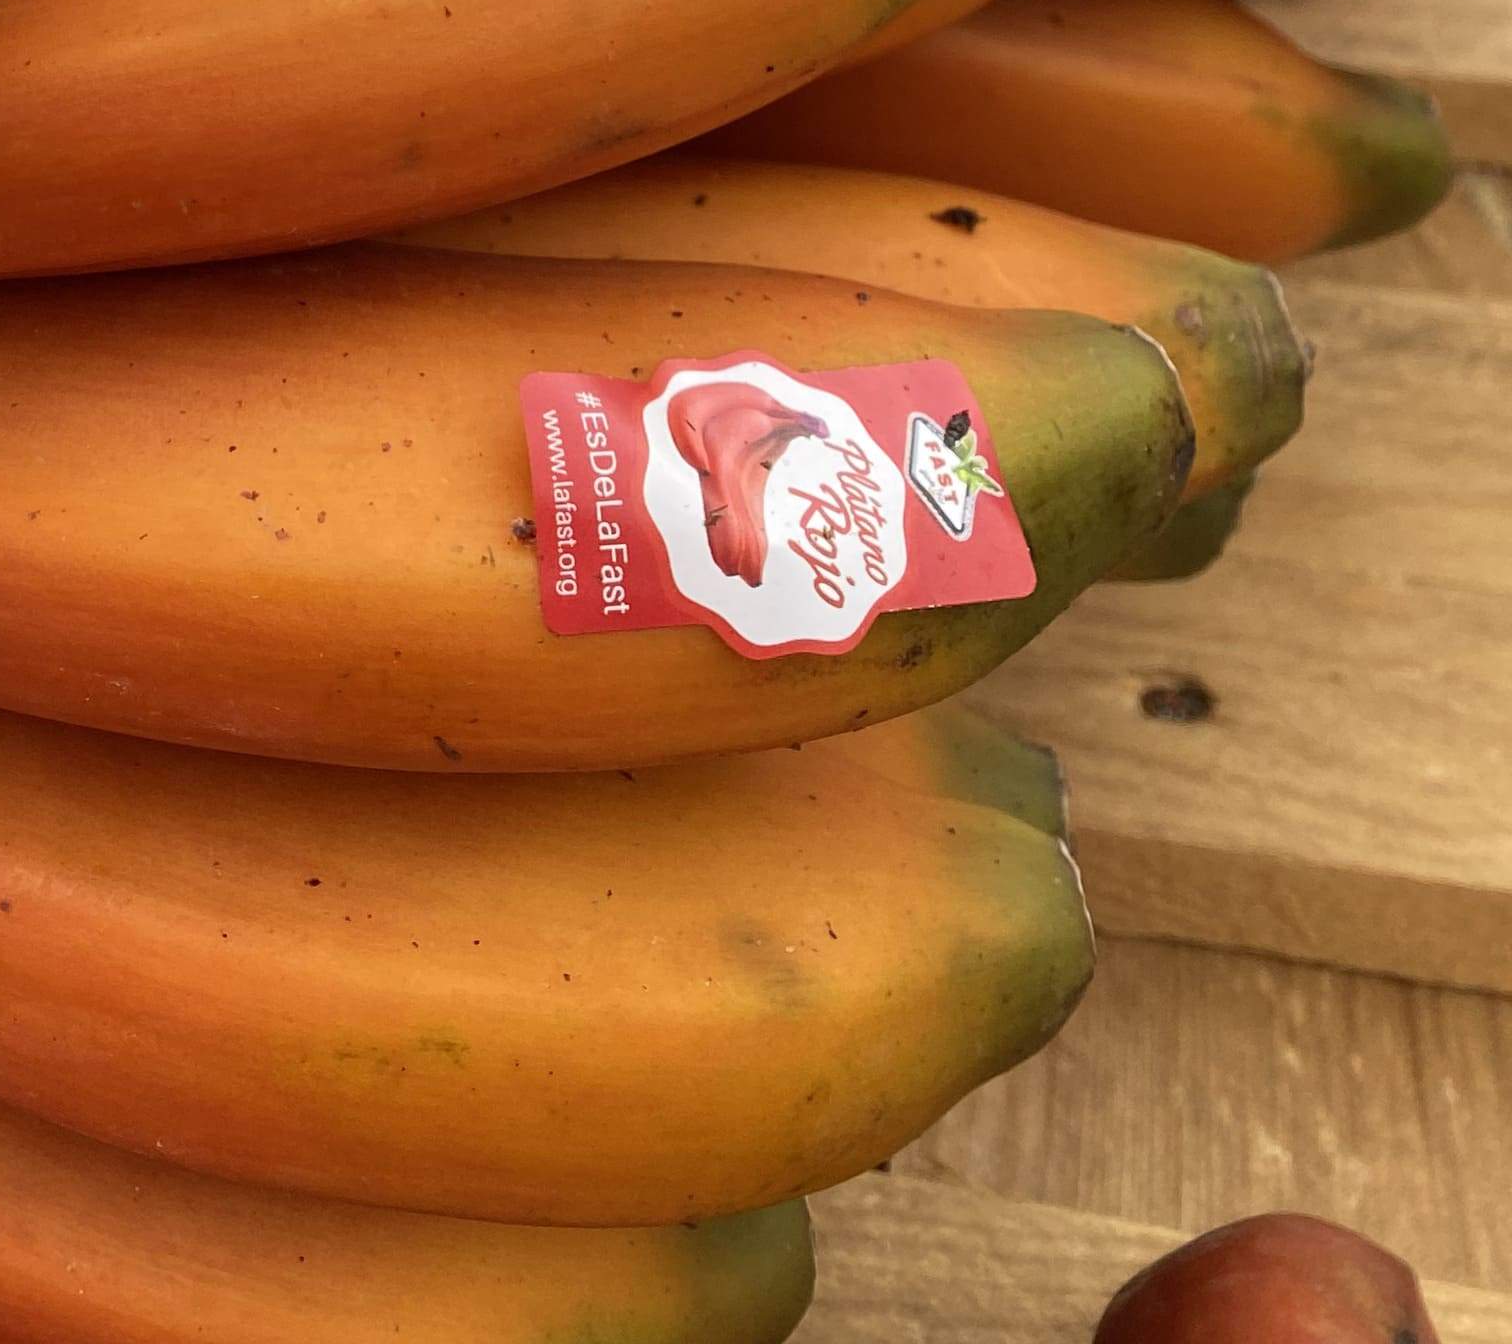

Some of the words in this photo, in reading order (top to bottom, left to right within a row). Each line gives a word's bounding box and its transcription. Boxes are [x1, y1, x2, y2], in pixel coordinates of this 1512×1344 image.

[541, 409, 578, 597] www.lafast.org
[575, 391, 631, 616] #EsDeLaFast
[787, 483, 858, 609] Rojo
[826, 438, 887, 587] Plátano
[924, 440, 959, 506] FAST
